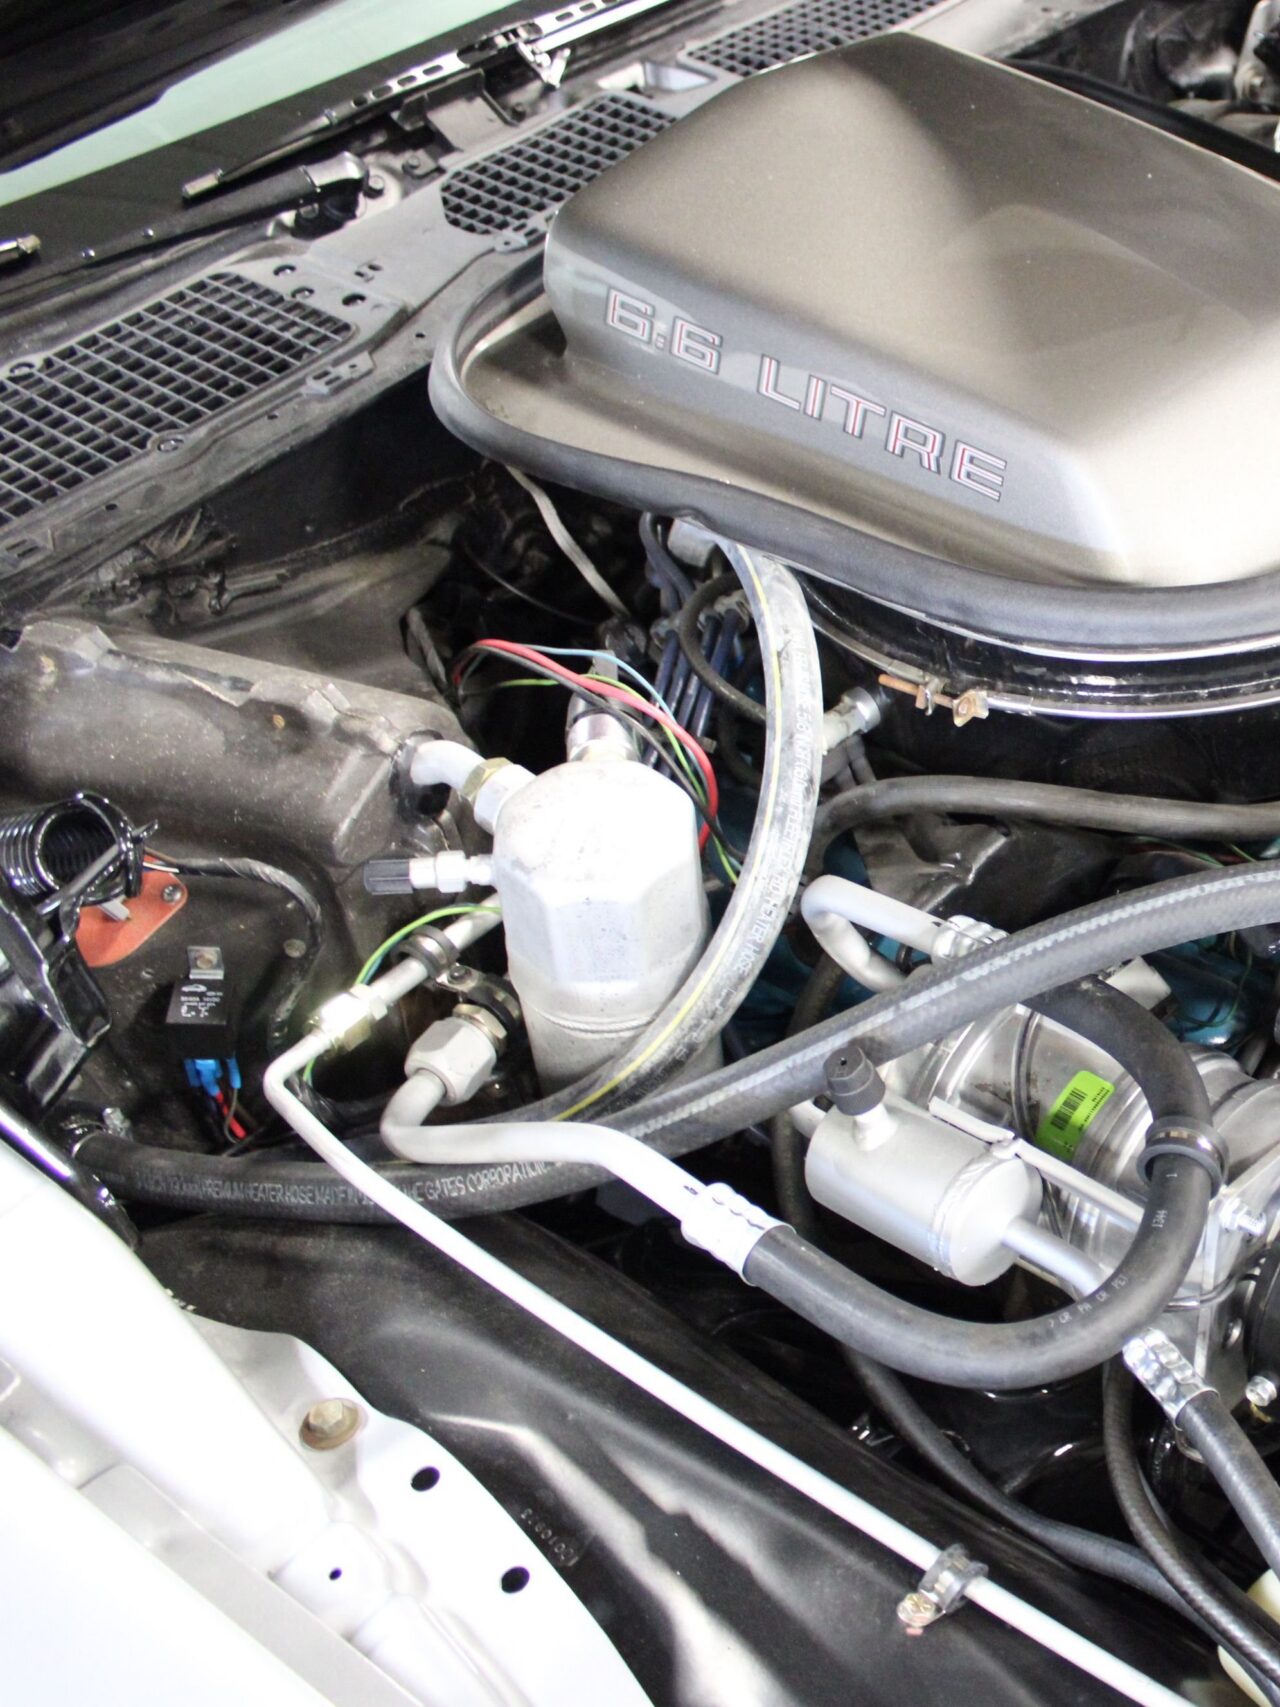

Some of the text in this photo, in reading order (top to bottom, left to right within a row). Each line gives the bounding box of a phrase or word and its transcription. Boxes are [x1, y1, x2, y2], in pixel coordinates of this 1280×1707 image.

[606, 287, 1007, 502] 6.6 LITRE
[248, 1181, 285, 1203] HEATER
[286, 1183, 314, 1205] HOSE
[424, 1174, 466, 1200] GATES
